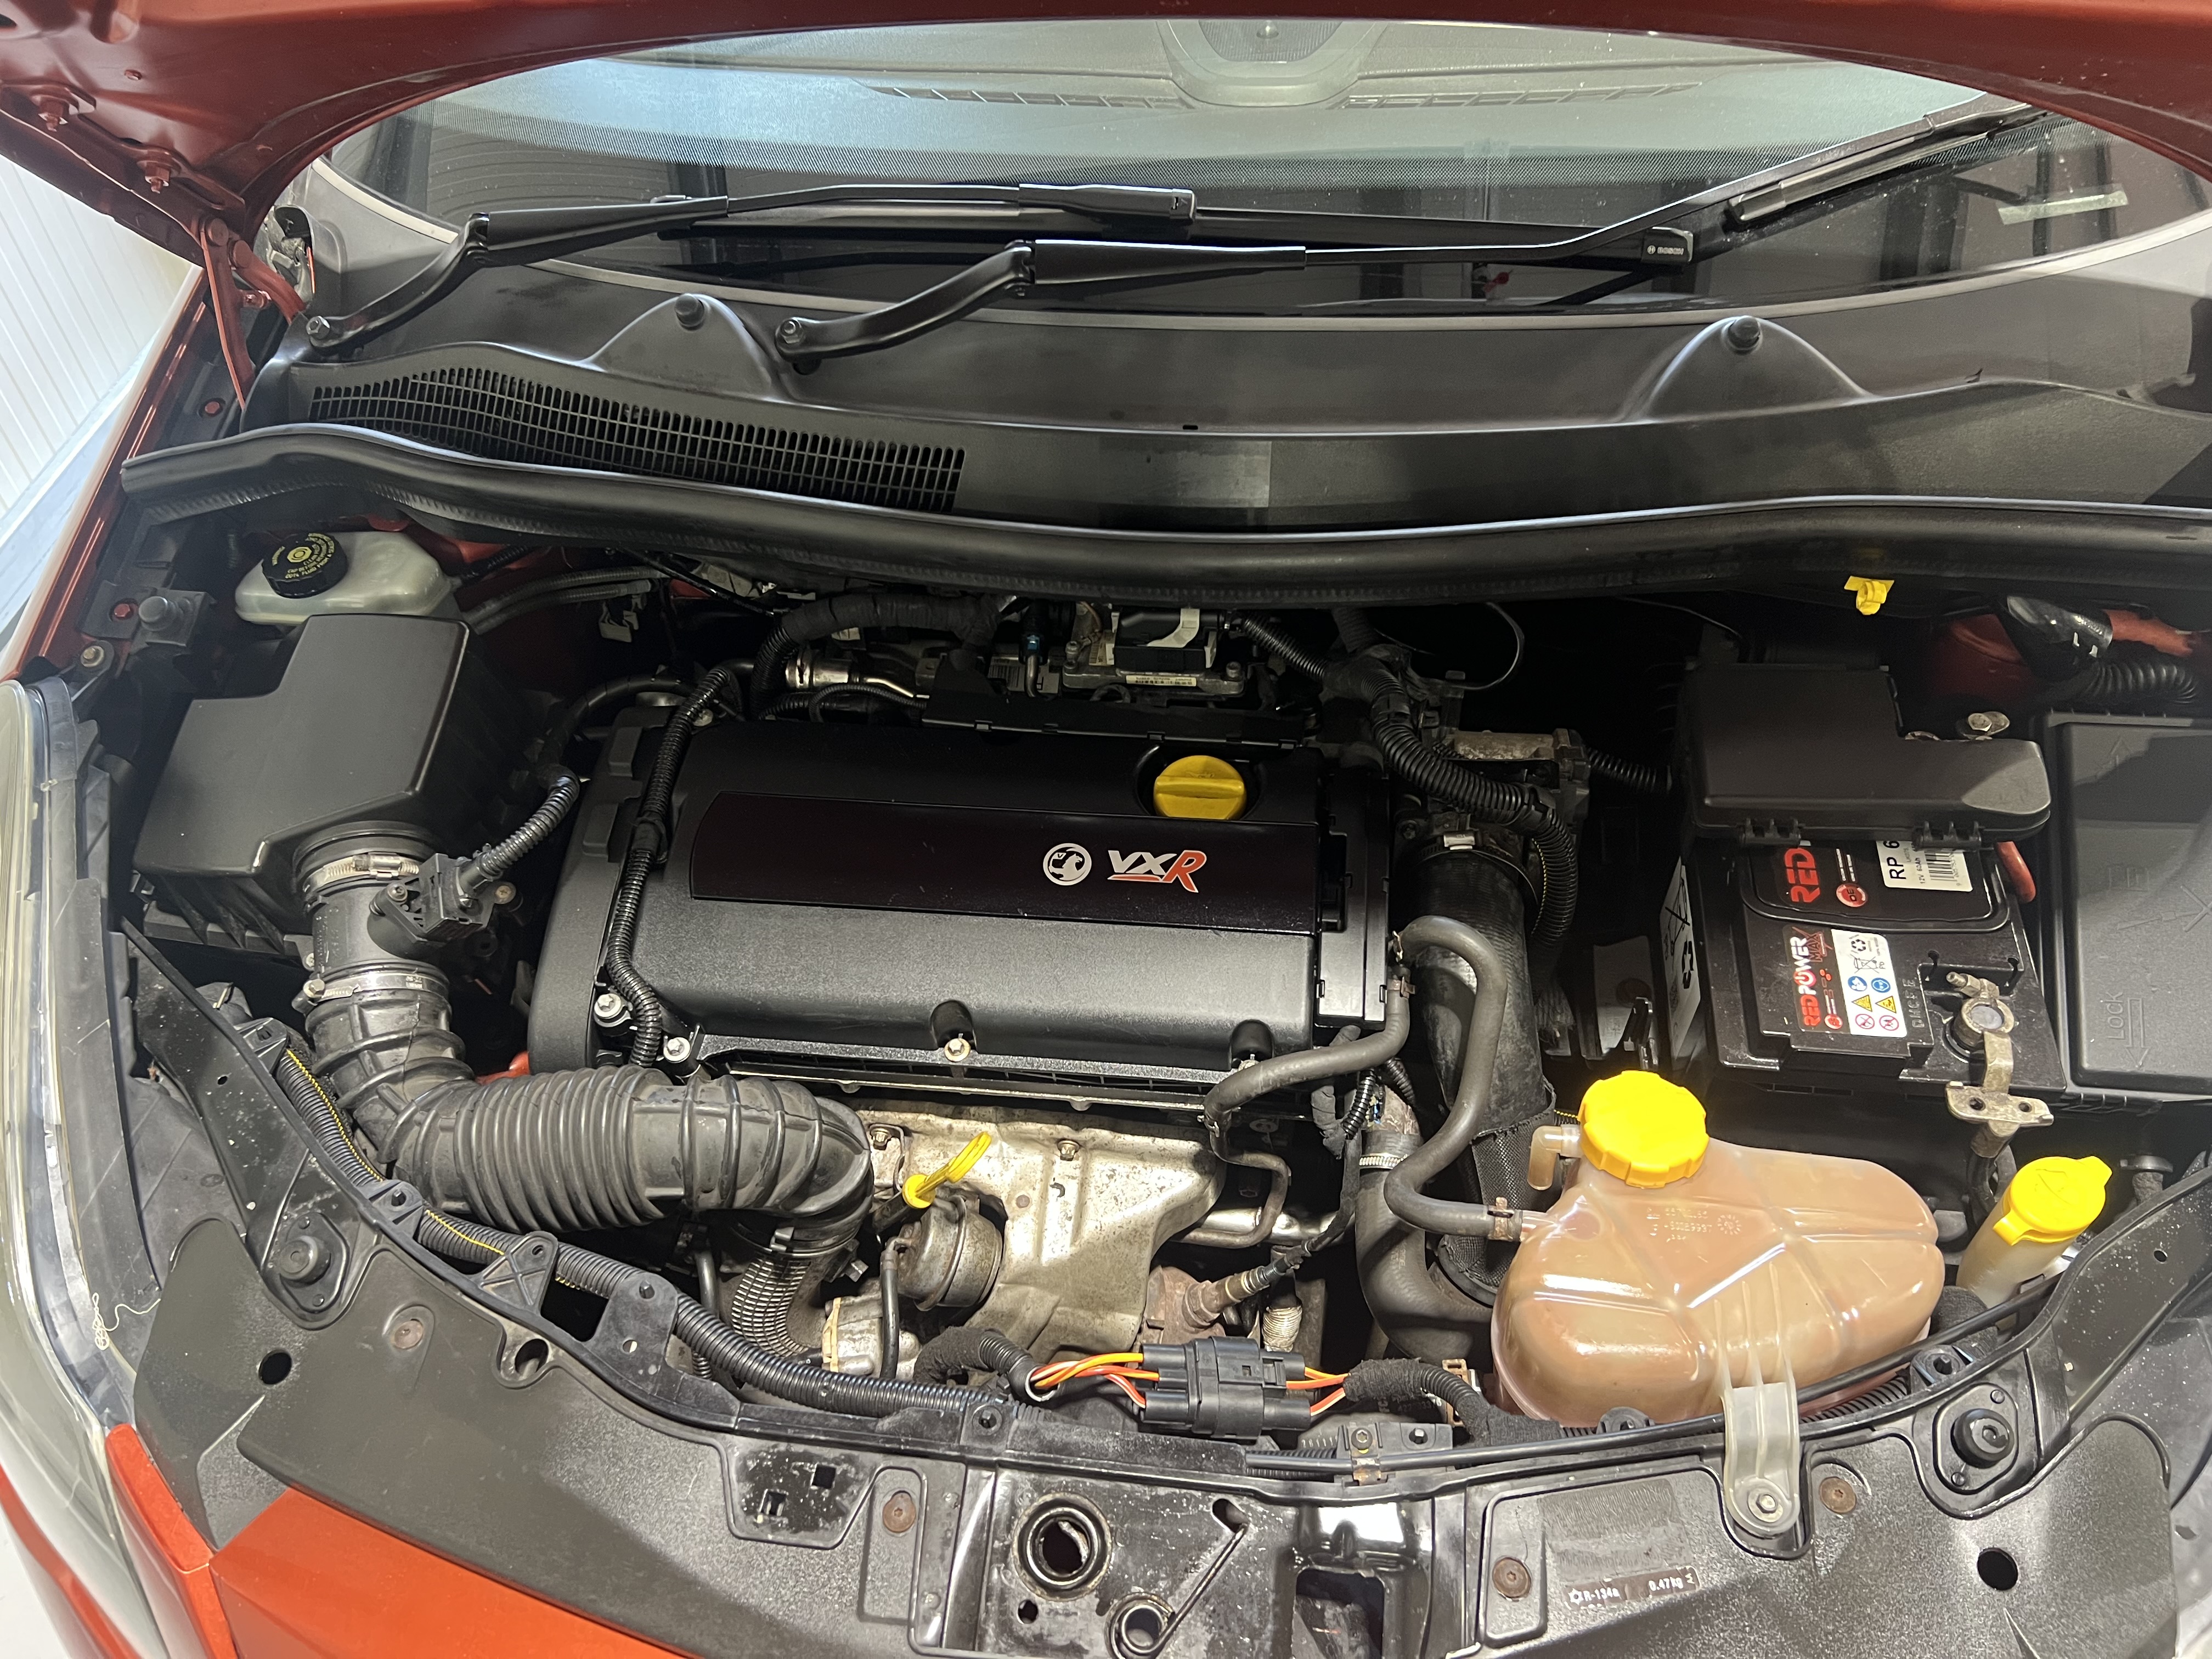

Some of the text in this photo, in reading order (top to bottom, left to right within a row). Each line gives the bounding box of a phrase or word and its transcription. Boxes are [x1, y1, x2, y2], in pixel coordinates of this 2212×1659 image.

[1657, 247, 1684, 255] BOSCH
[1108, 850, 1207, 893] VXR
[1783, 848, 1820, 904] RED
[1886, 857, 1906, 880] RP
[1806, 933, 1822, 962] MAX
[1879, 961, 1886, 969] Pb
[2104, 992, 2125, 1040] LOCK
[1583, 1586, 1620, 1601] R-134a
